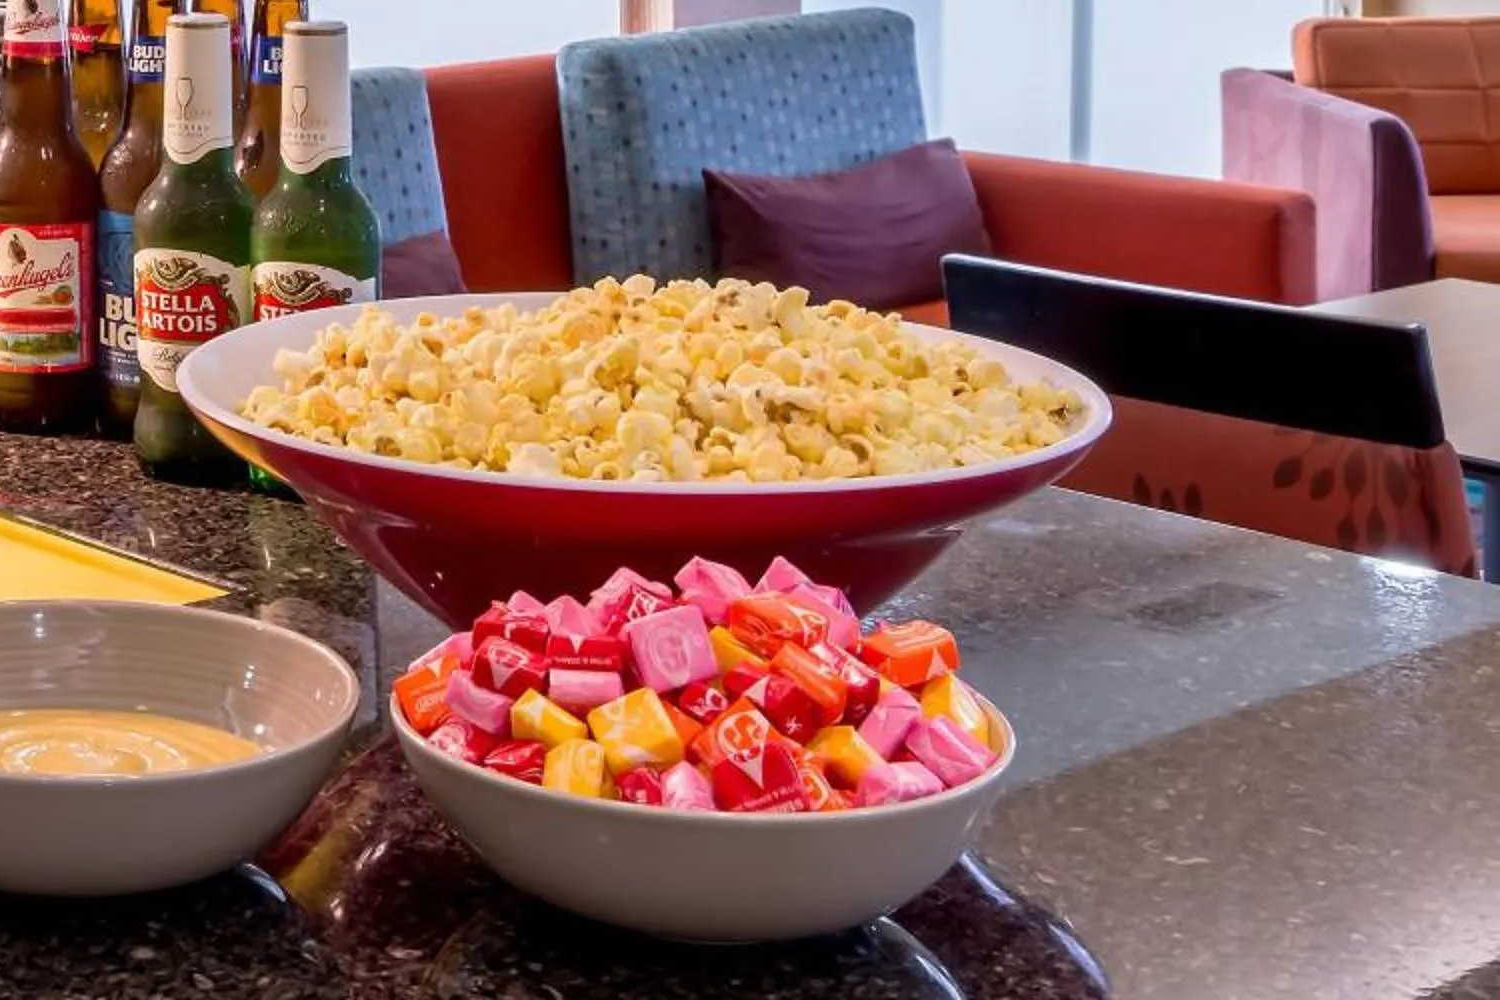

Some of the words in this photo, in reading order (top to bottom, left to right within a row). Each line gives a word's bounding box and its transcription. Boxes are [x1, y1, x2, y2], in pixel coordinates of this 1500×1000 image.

[133, 45, 165, 59] BUD
[105, 293, 137, 324] BU
[141, 289, 216, 313] STELLA
[99, 317, 138, 351] LIG
[141, 311, 218, 333] ARTOIS
